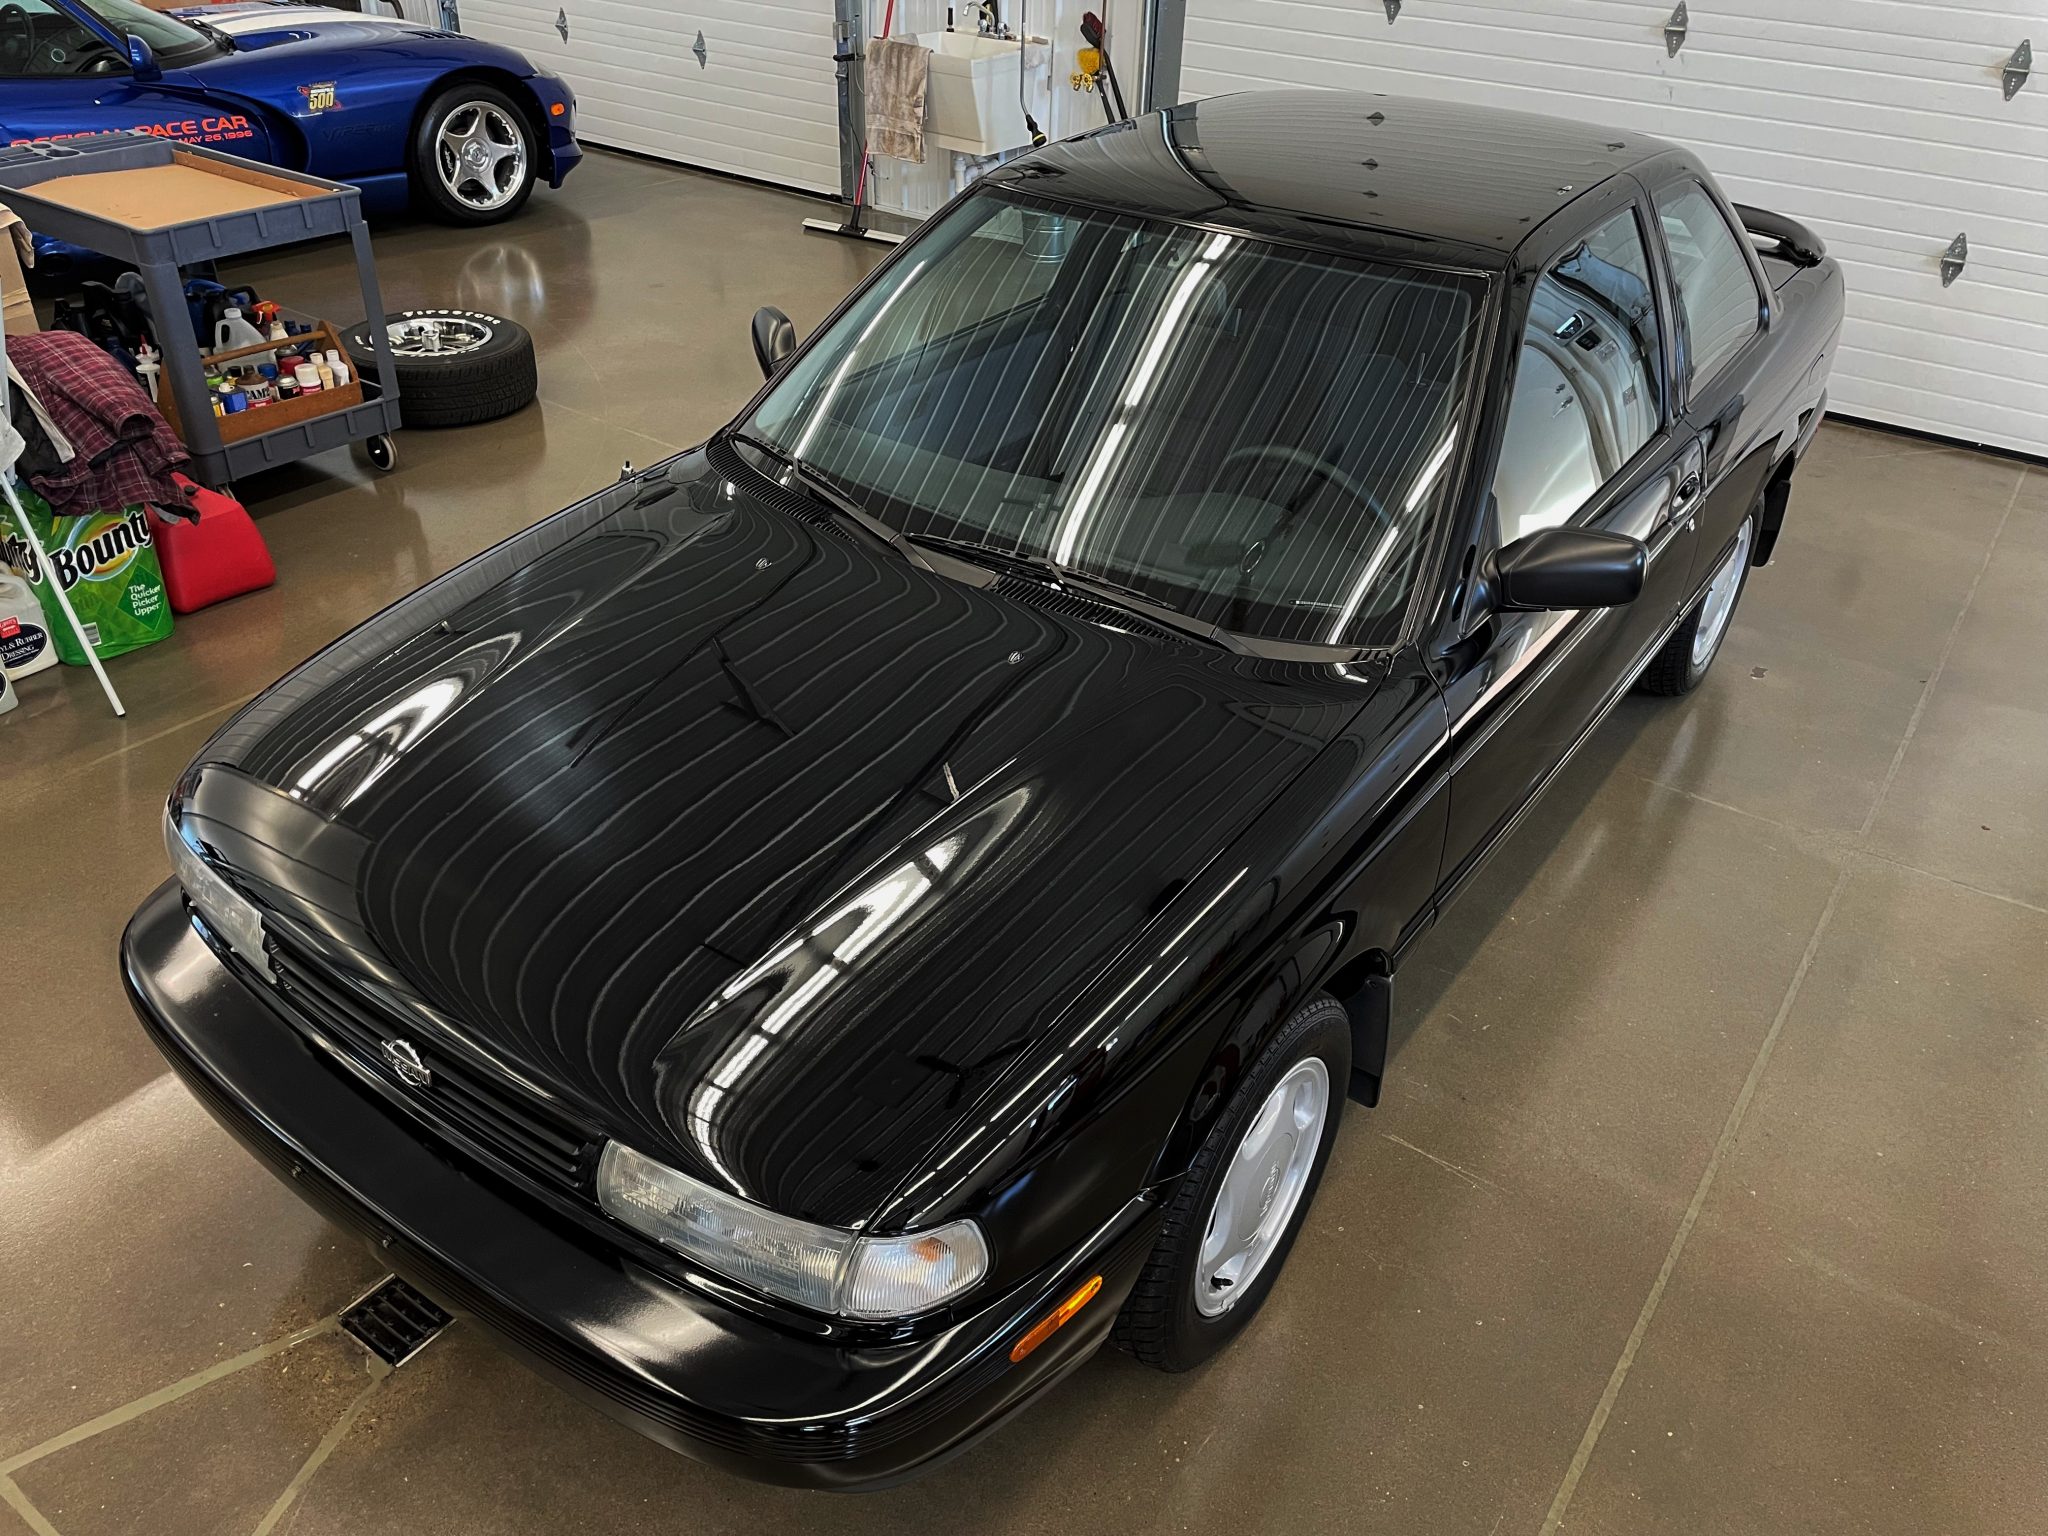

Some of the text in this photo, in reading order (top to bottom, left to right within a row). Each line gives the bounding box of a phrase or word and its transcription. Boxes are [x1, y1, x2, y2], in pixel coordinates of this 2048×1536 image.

[309, 91, 334, 110] 500
[202, 115, 249, 132] CAR
[48, 511, 153, 592] Bounty
[128, 584, 146, 593] The
[130, 584, 161, 601] Quicker
[132, 595, 159, 609] Picker
[134, 602, 162, 616] Upper
[381, 1044, 431, 1087] NISSAN
